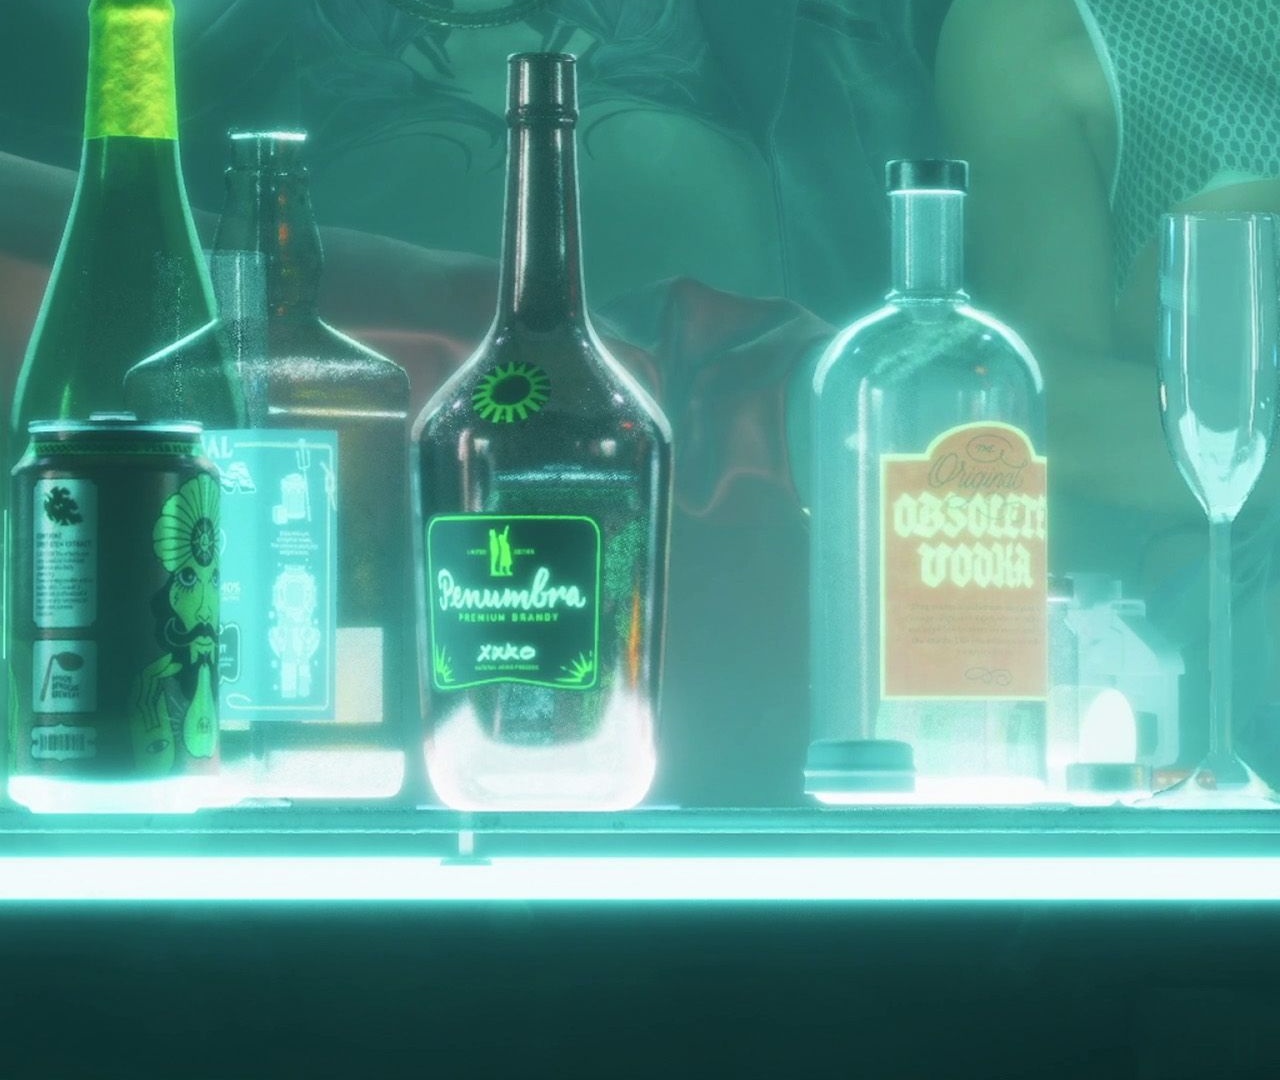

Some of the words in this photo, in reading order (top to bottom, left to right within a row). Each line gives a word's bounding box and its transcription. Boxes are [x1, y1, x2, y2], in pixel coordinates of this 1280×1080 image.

[927, 453, 1025, 494] Original
[437, 566, 587, 611] Penumbra
[458, 612, 506, 623] PREMIUM
[511, 612, 559, 622] BRANDY
